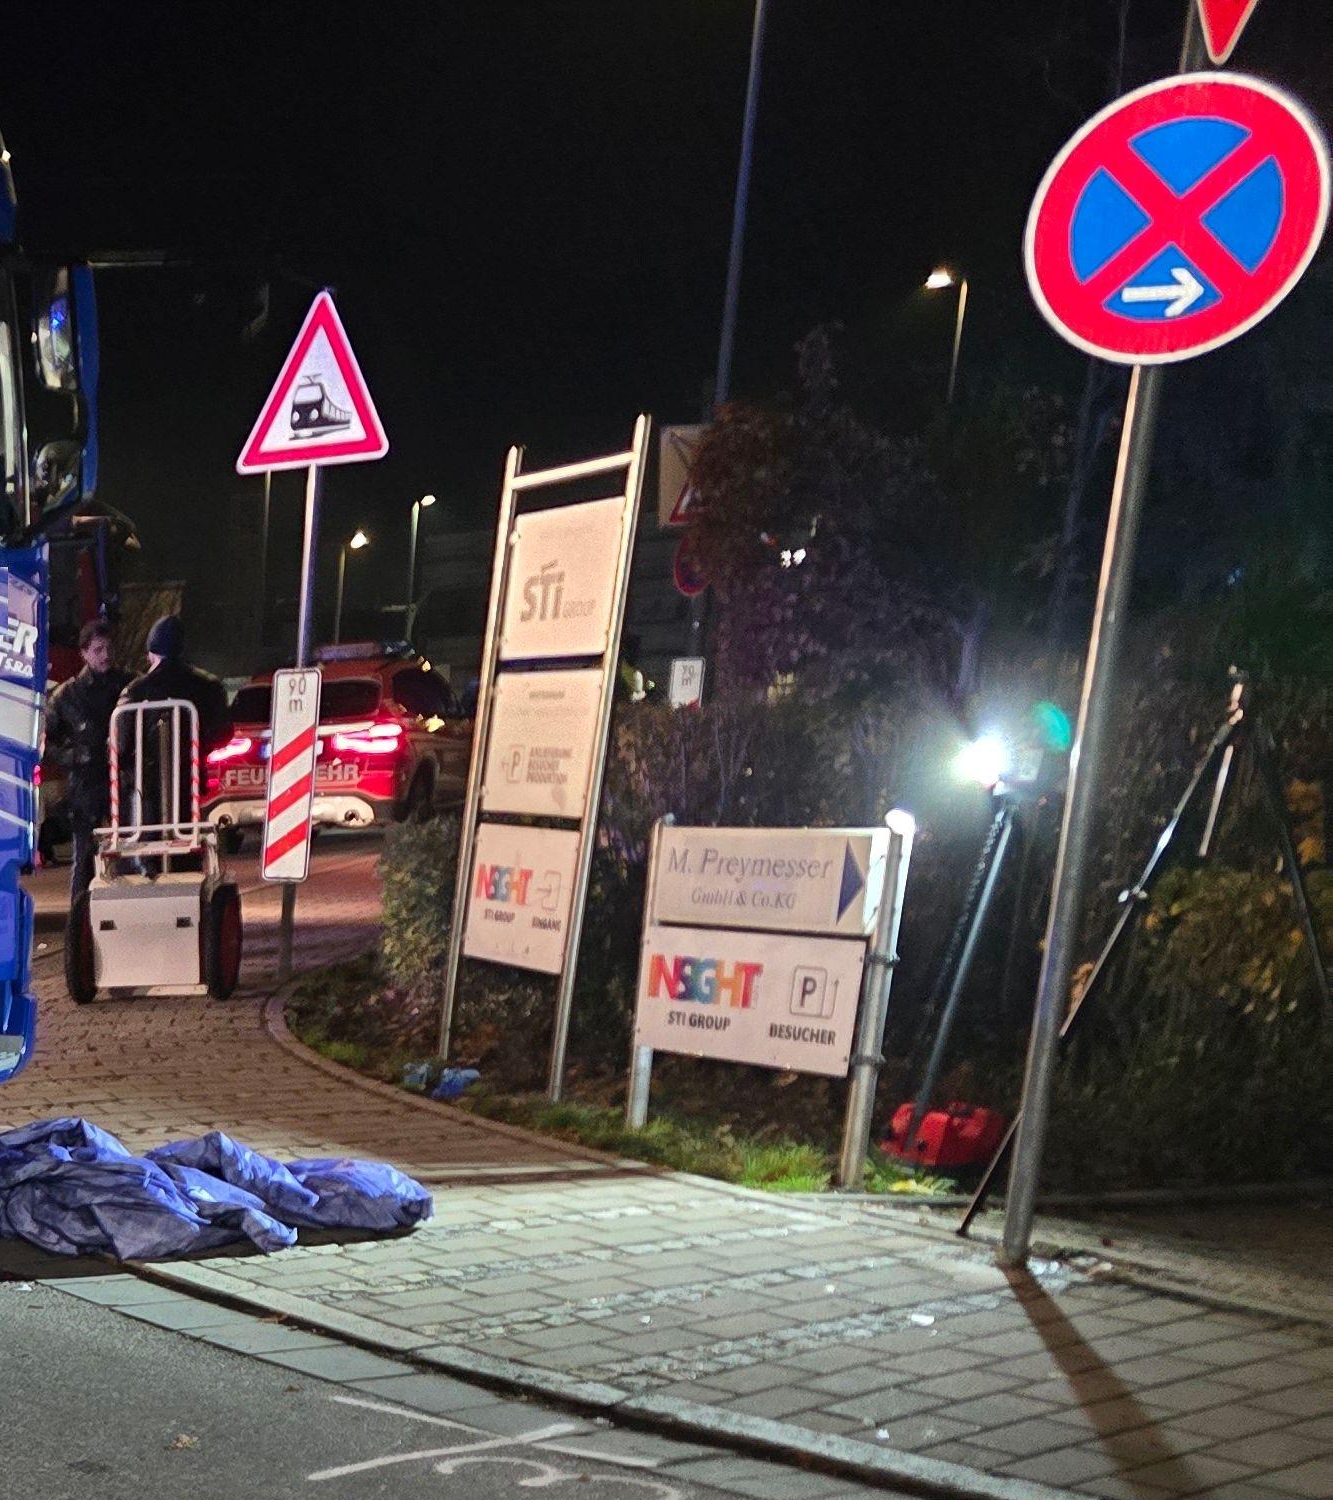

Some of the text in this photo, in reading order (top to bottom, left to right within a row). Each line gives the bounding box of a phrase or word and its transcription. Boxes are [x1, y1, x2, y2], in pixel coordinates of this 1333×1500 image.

[289, 678, 307, 695] 90
[289, 699, 303, 712] m
[668, 848, 833, 883] M. Preymesser
[691, 887, 733, 905] GmbH
[736, 889, 748, 906] &
[800, 976, 817, 1008] P
[668, 1011, 731, 1031] STI GROUP
[769, 1022, 836, 1046] BESUCHER
